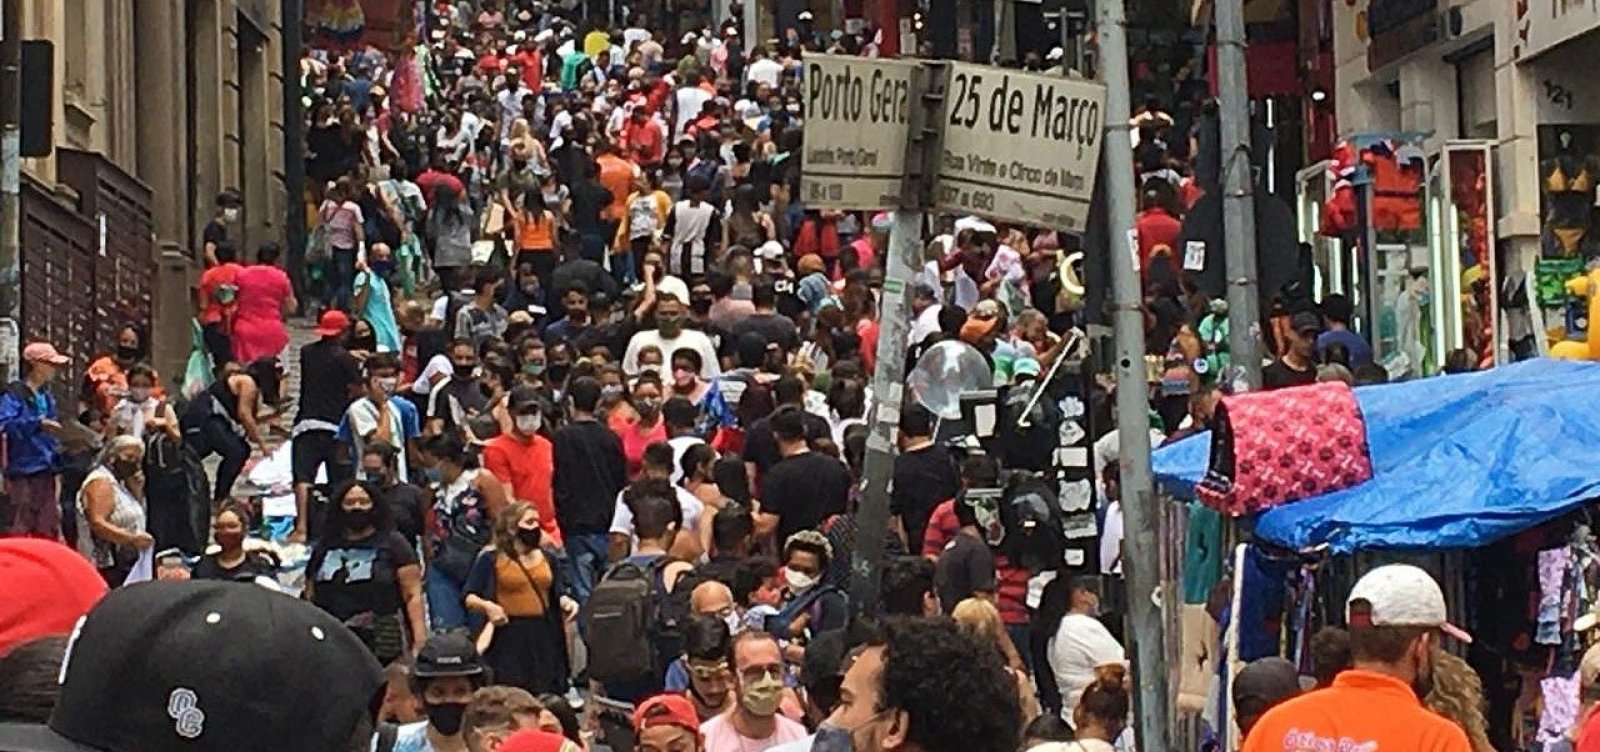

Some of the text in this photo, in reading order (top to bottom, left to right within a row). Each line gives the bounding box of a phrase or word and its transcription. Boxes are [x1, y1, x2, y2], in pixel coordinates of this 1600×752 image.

[808, 63, 910, 124] Porto Gera
[950, 73, 1099, 160] 25 de Março
[1543, 79, 1573, 110] 121
